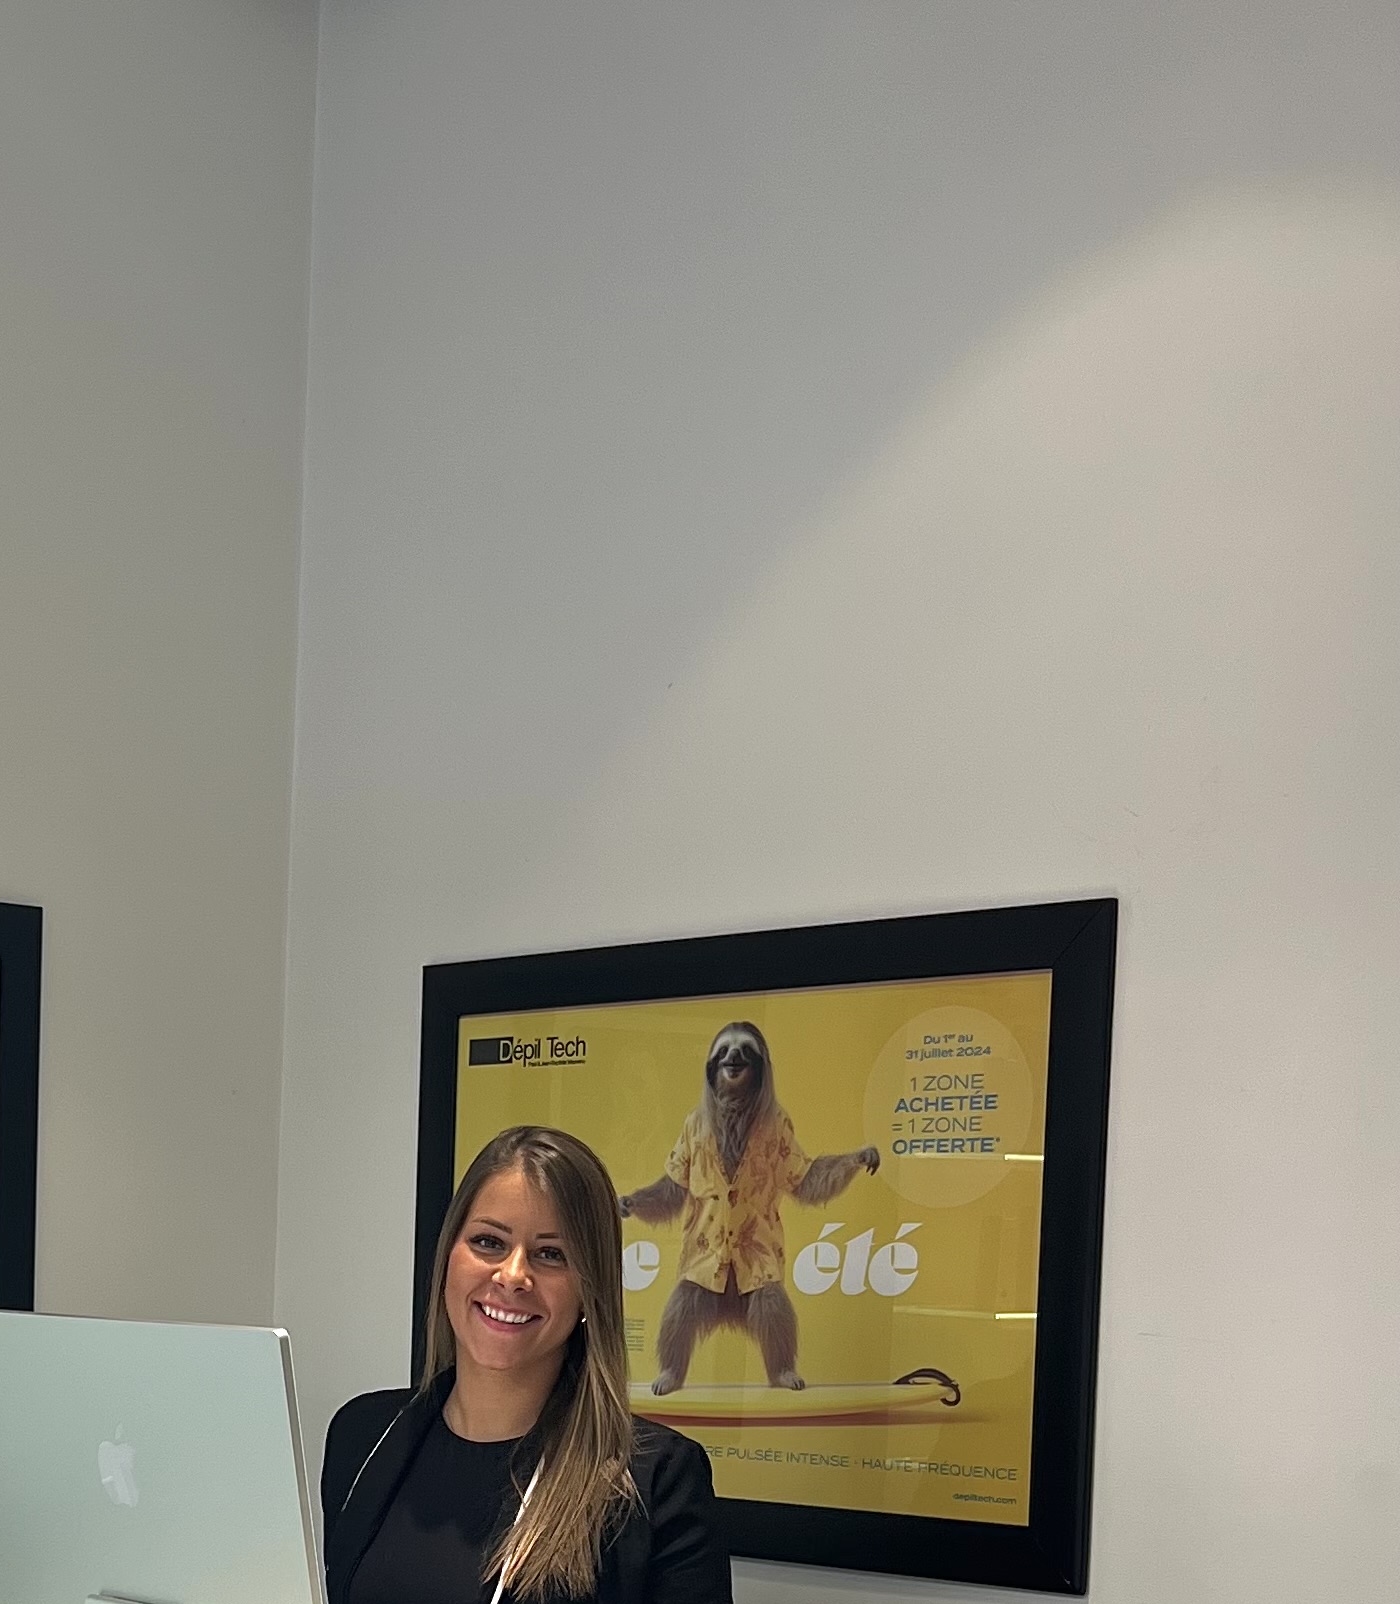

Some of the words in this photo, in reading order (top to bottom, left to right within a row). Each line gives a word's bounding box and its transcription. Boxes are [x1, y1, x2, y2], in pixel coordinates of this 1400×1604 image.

[923, 1035, 941, 1045] Du
[957, 1034, 974, 1043] au
[499, 1038, 541, 1067] Dépil
[546, 1036, 586, 1058] Tech
[905, 1049, 918, 1060] 31
[919, 1048, 954, 1062] juillet
[956, 1046, 992, 1057] 2024
[910, 1077, 917, 1092] 1
[922, 1073, 985, 1092] ZONE
[894, 1090, 999, 1113] ACHETÉE
[908, 1118, 915, 1134] 1
[921, 1116, 983, 1133] ZONE
[793, 1222, 923, 1297] été
[727, 1446, 783, 1463] PULSÉE
[786, 1452, 849, 1468] INTENSE
[862, 1458, 913, 1473] HAUTE
[917, 1461, 1017, 1481] FRÉQUENCE
